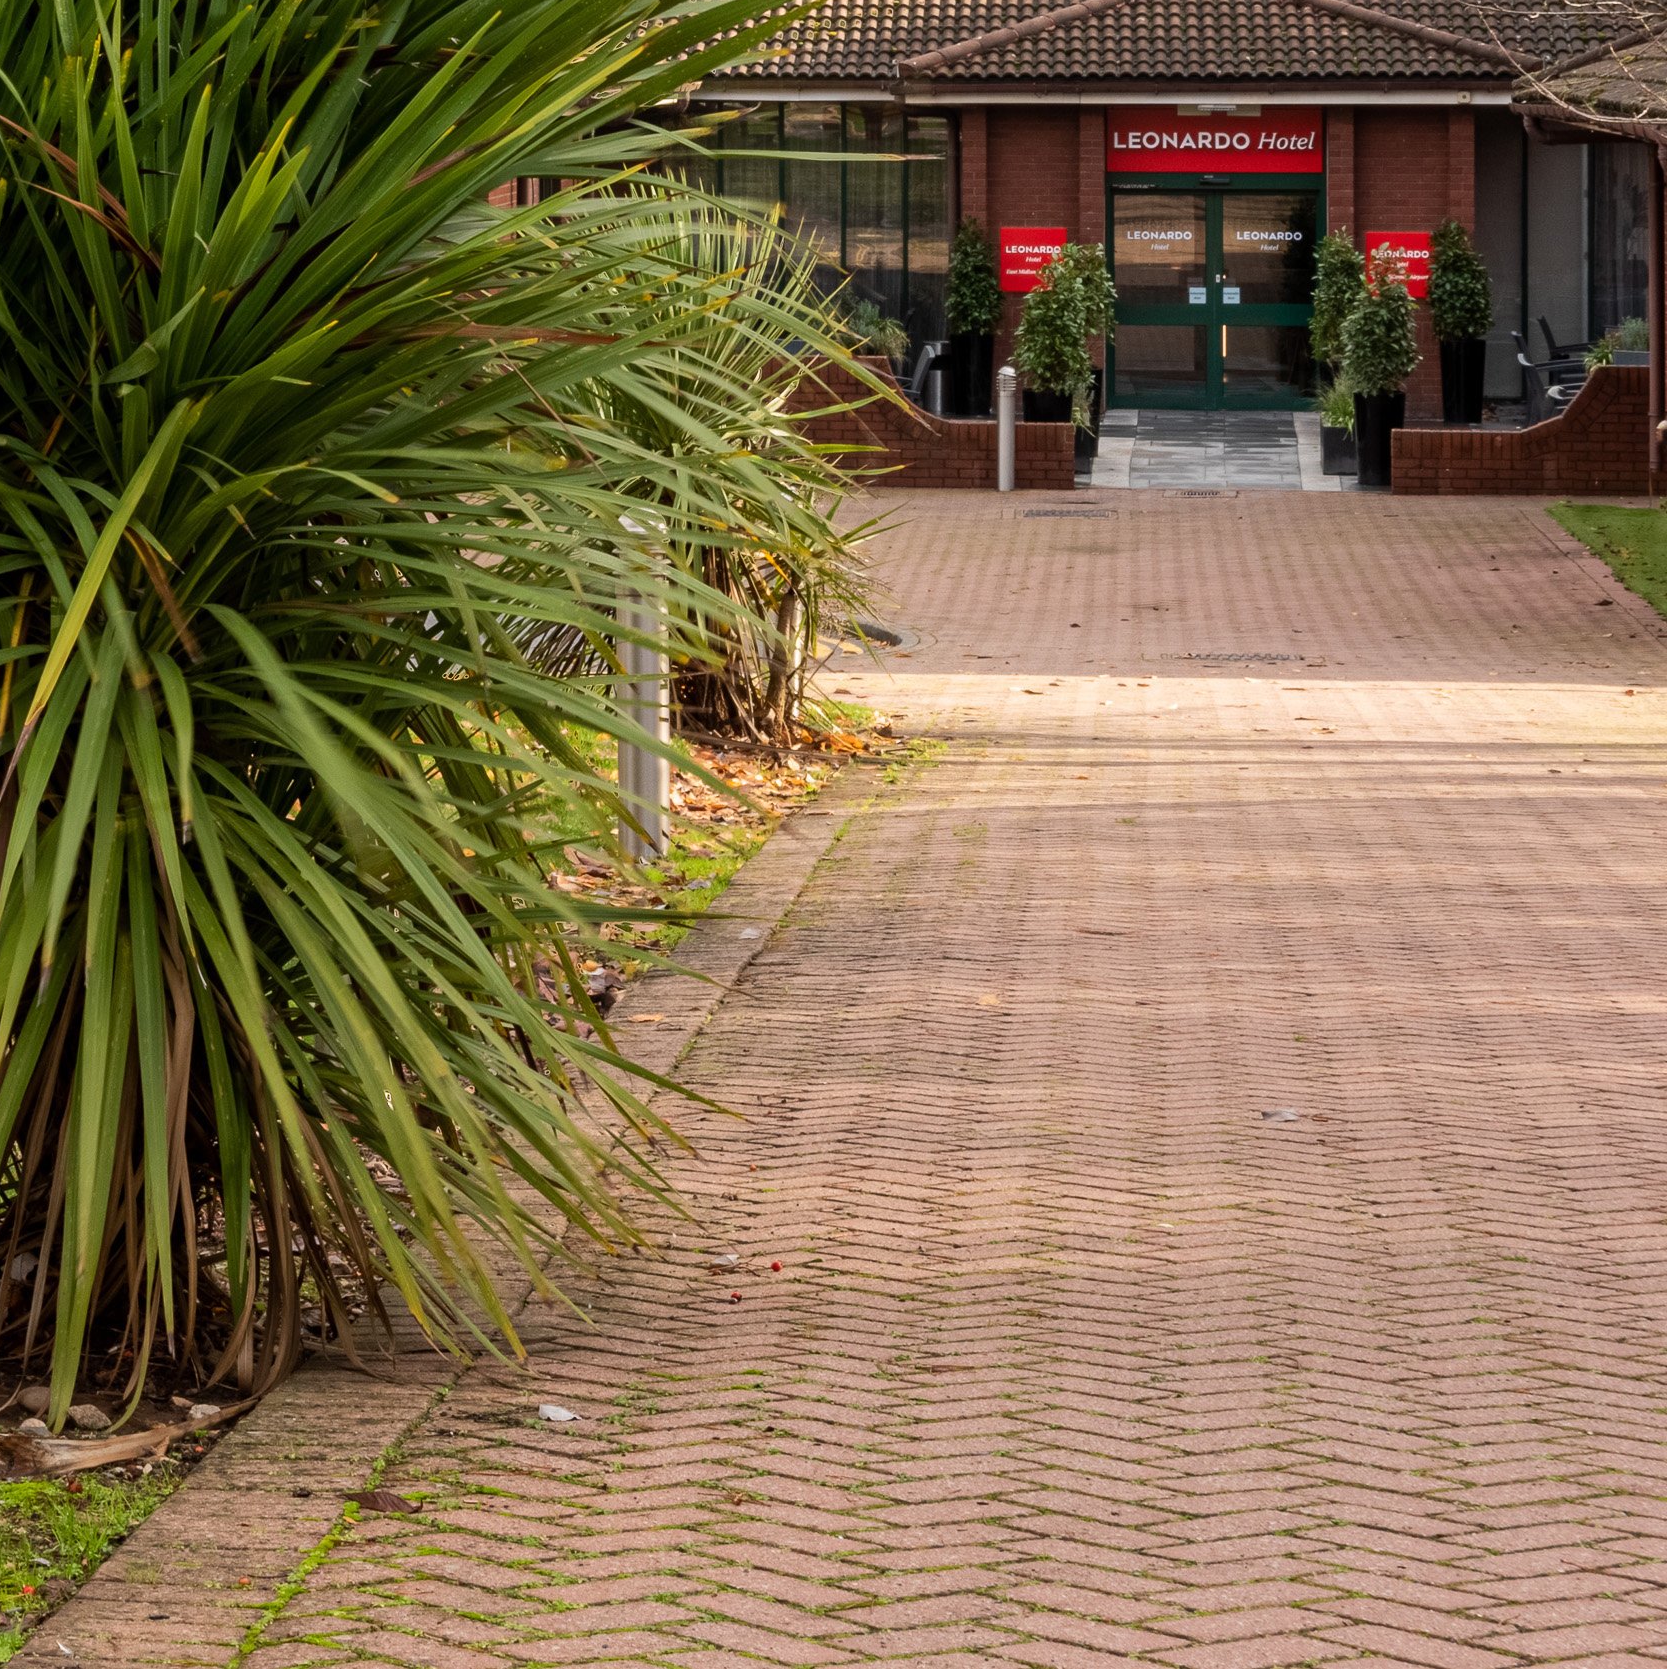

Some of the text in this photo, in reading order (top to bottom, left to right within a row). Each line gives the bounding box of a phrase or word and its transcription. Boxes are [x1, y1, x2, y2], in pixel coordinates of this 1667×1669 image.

[1113, 131, 1316, 150] LEONARDO Hotel
[1127, 230, 1193, 240] LEONARDO
[1236, 231, 1303, 241] LEONARDO
[1005, 245, 1061, 254] LEONARDO
